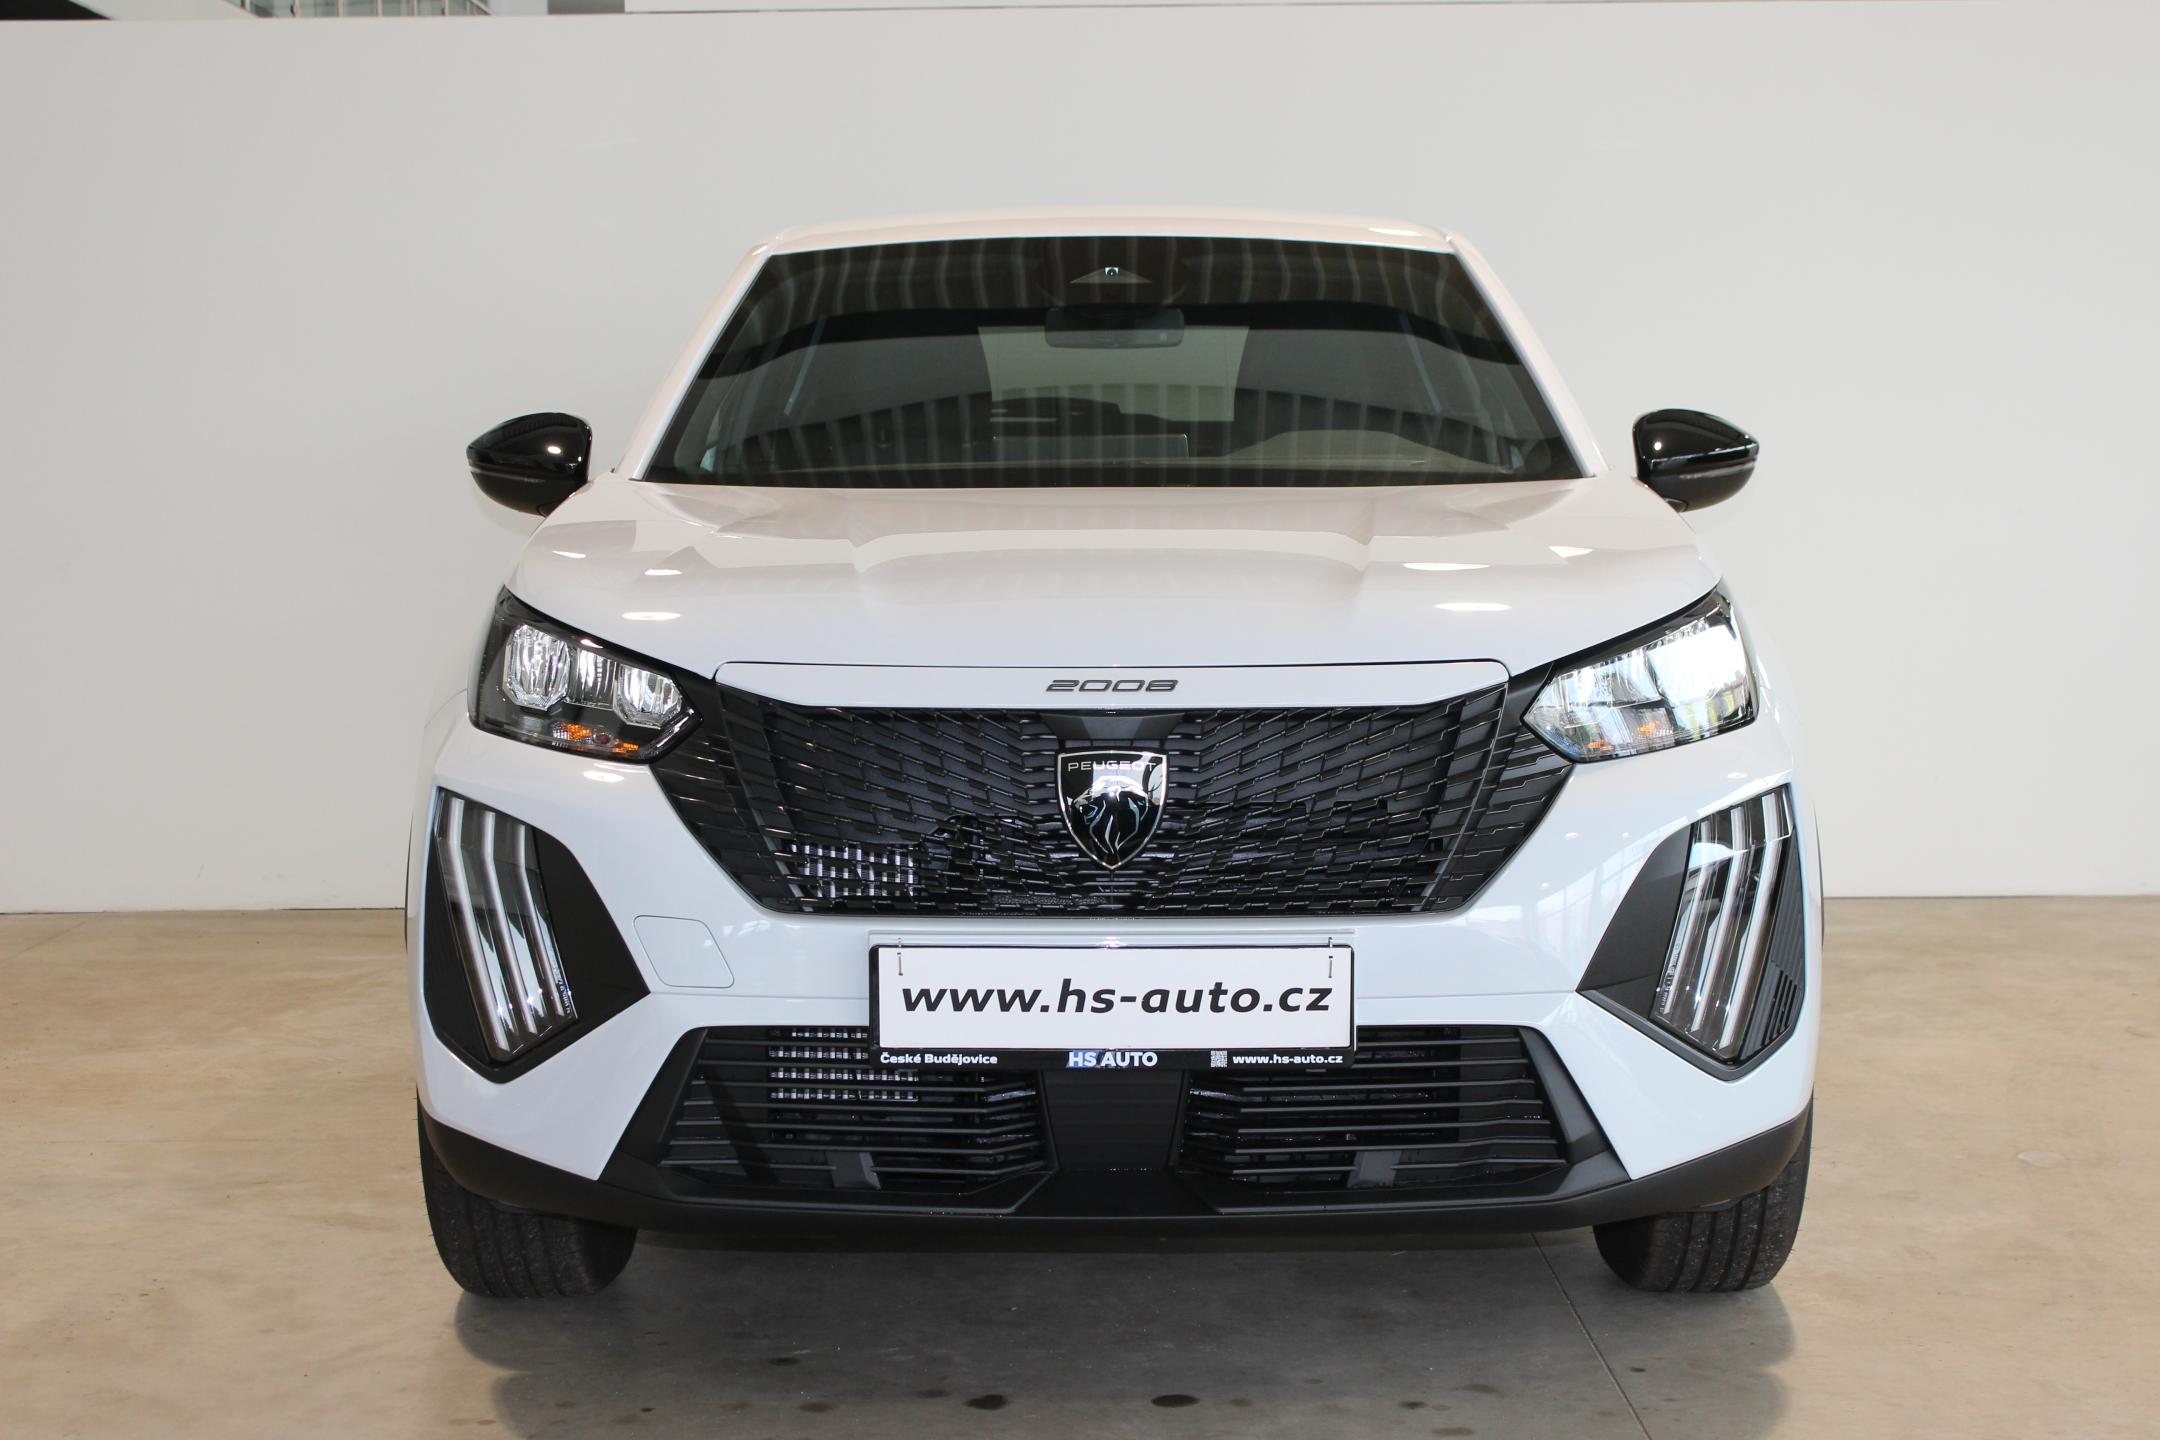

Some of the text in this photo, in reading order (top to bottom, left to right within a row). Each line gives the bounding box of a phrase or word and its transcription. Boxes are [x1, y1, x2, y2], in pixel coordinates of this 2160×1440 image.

[1045, 679, 1179, 693] 2008
[1066, 760, 1157, 772] PEUGEOT
[902, 978, 1334, 1014] www.hs-auto.cz
[879, 1051, 998, 1066] České Budějovice
[1068, 1051, 1158, 1067] HS AUTO
[1232, 1053, 1344, 1065] www.hs-auto.cz
